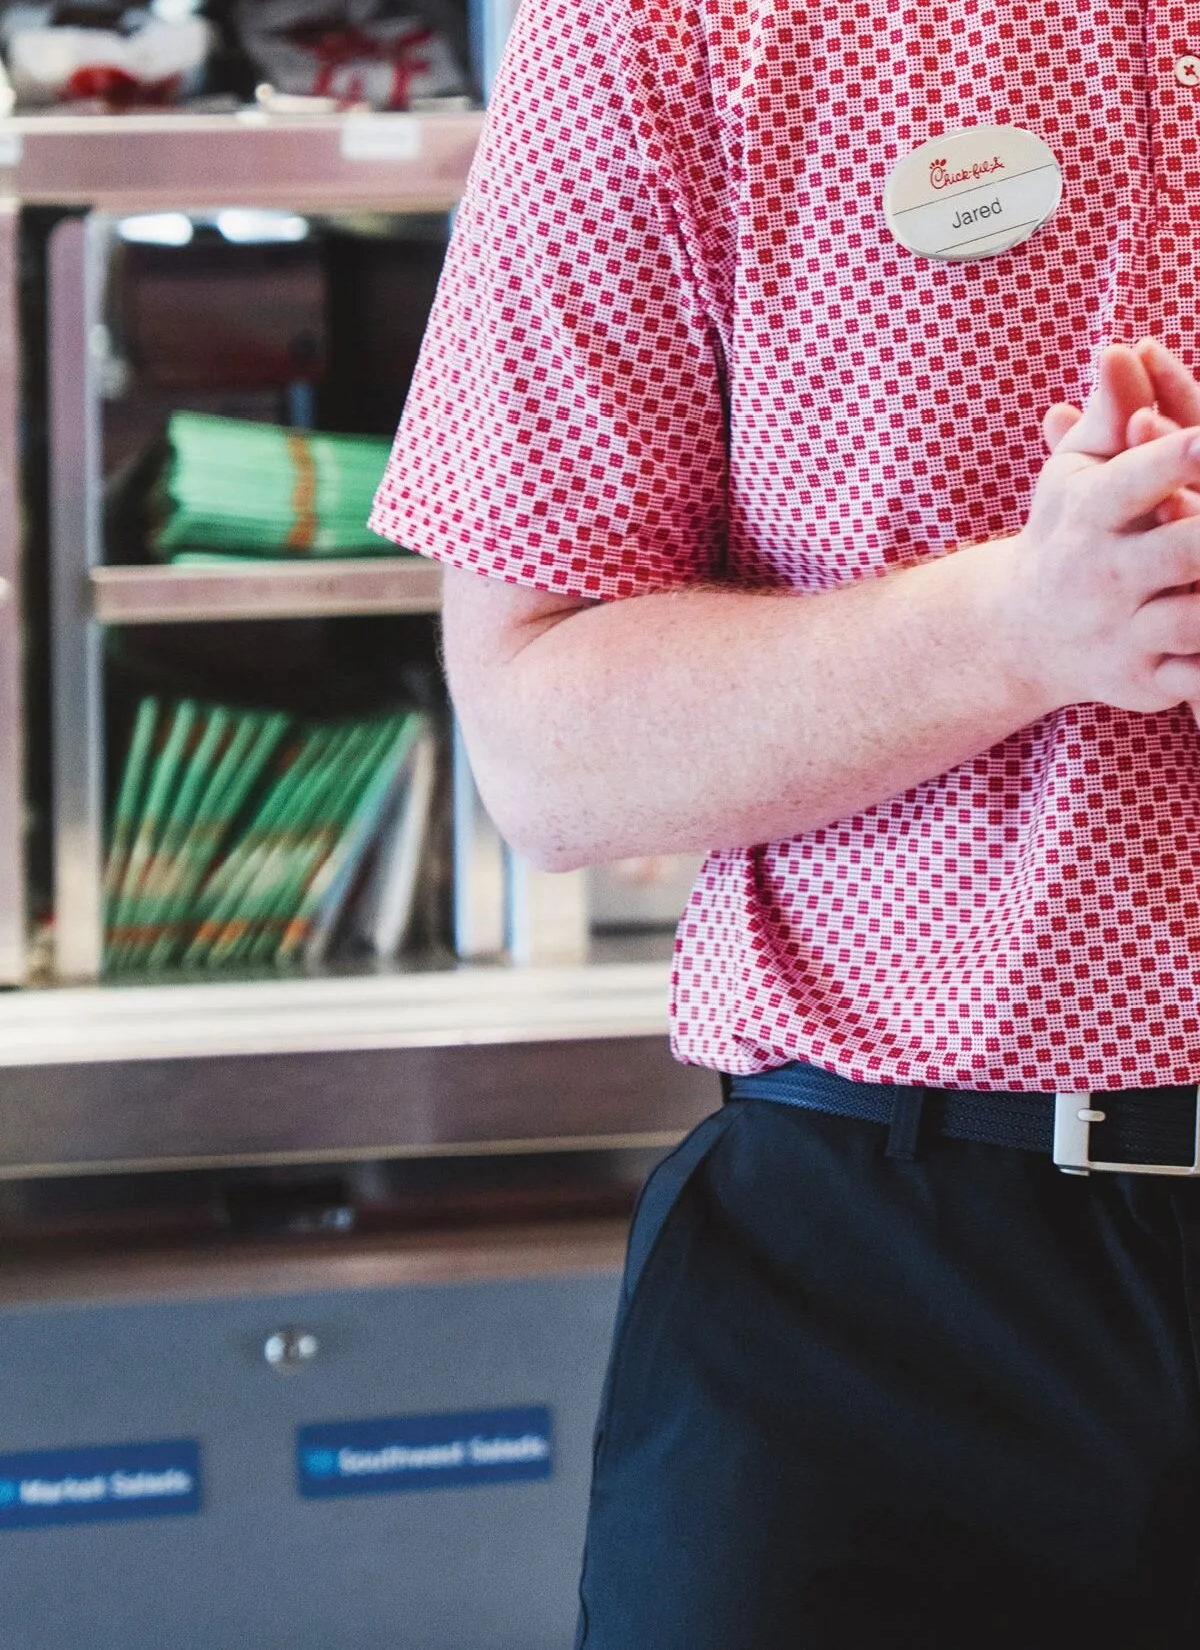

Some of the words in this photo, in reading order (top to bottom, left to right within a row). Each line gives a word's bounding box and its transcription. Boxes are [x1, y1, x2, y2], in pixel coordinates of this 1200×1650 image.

[929, 156, 1005, 189] Chick-fil-A
[952, 197, 1003, 229] Jared
[339, 1442, 464, 1475] Southwest
[469, 1433, 548, 1464] Salads
[20, 1474, 105, 1505] Market
[109, 1467, 193, 1498] Salads
